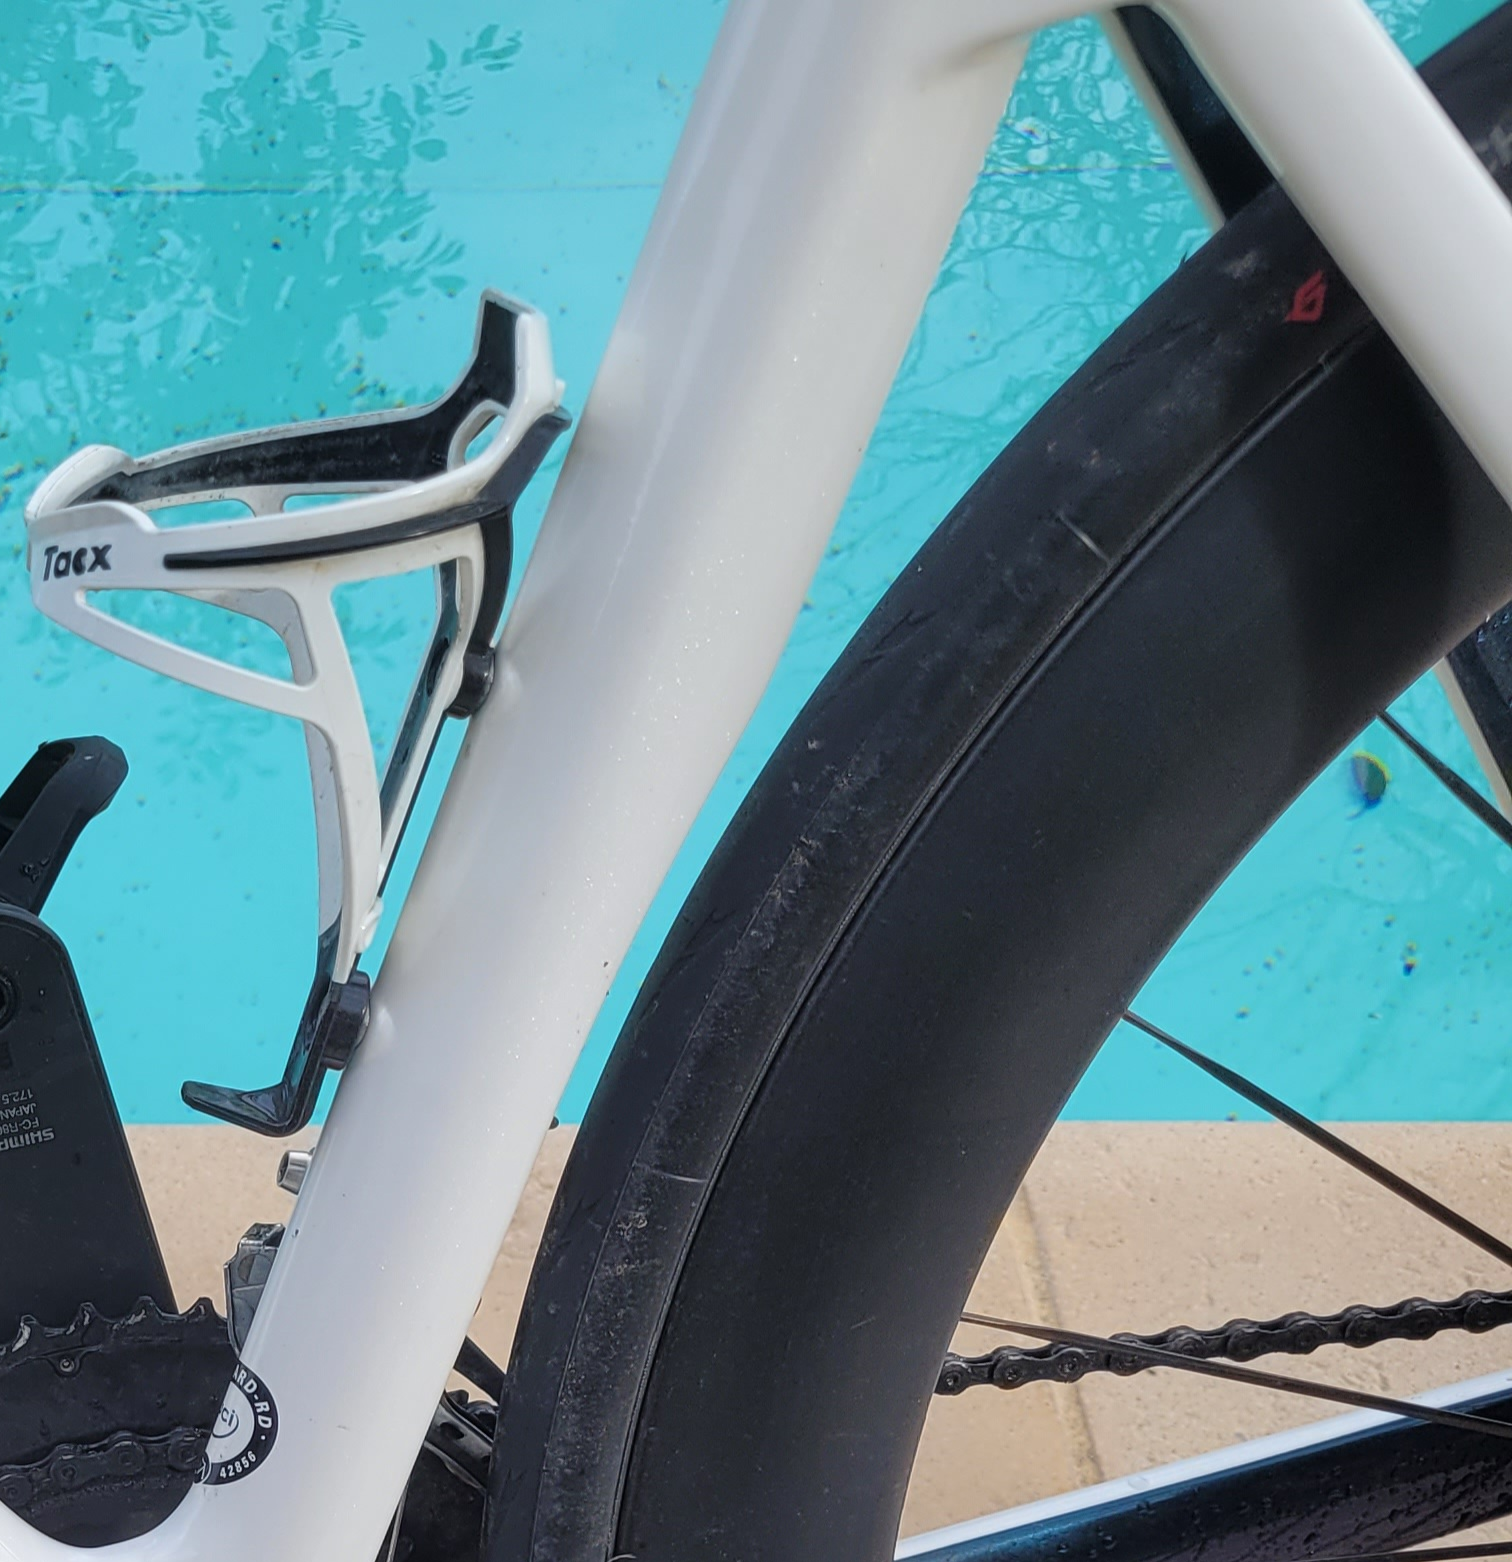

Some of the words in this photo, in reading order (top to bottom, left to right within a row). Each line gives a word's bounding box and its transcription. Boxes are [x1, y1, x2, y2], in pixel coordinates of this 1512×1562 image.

[42, 543, 113, 582] Tacx
[1, 1088, 34, 1105] 172.5
[0, 1102, 37, 1120] JAPAN
[219, 1450, 257, 1479] 42856
